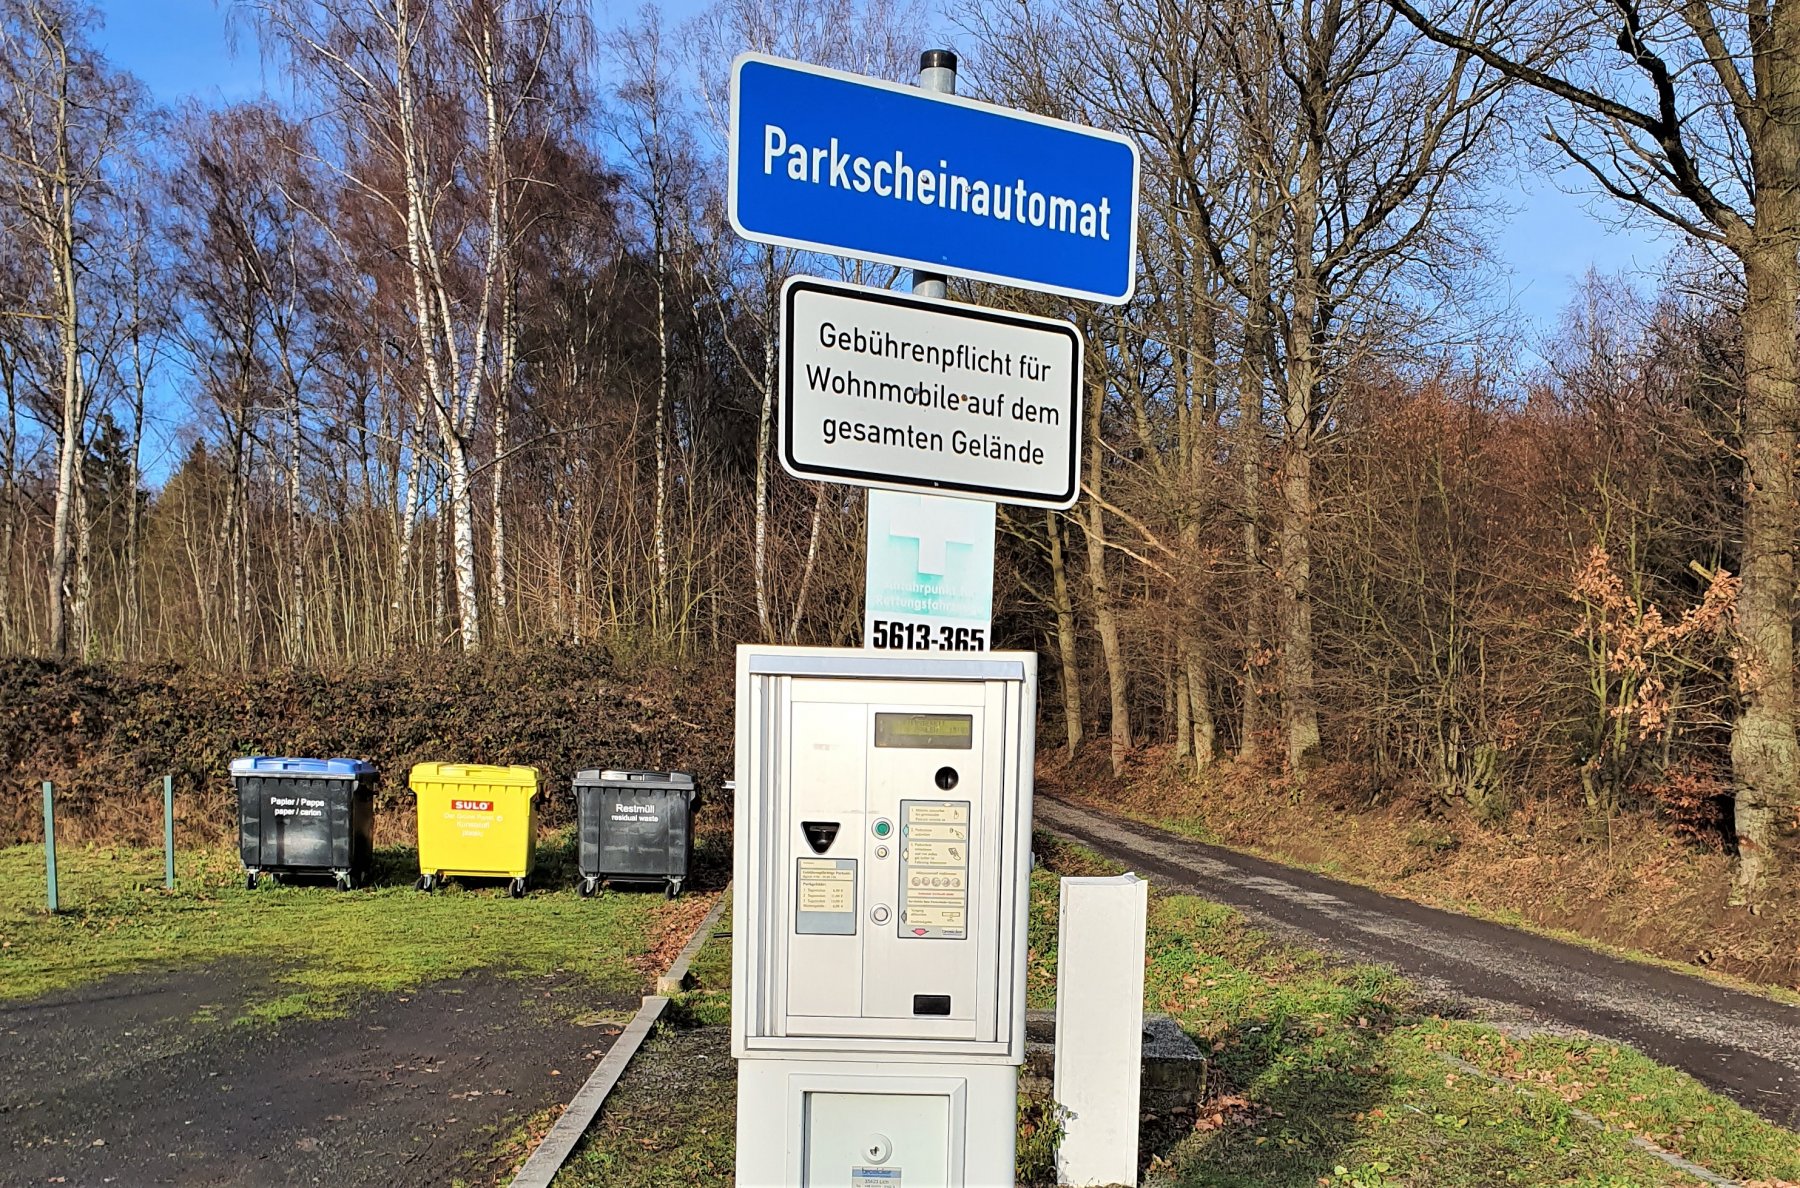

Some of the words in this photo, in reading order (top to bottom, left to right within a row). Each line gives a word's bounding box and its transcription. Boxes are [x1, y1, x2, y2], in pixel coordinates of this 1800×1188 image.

[763, 123, 1111, 240] Parkscheinautomat
[819, 322, 1012, 377] Gebührenpflicht
[1018, 354, 1051, 382] für
[806, 363, 960, 411] Wohnmobile
[967, 393, 1005, 418] auf
[1011, 396, 1059, 426] dem
[822, 417, 943, 452] gesamten
[951, 429, 1044, 465] Gelände
[873, 619, 985, 651] 5613-365
[270, 797, 295, 807] Papier
[300, 798, 325, 808] Pappe
[274, 808, 295, 816] paper
[455, 801, 489, 810] SULO
[615, 803, 655, 814] Restmüll
[611, 814, 638, 822] residual
[638, 815, 659, 823] waste
